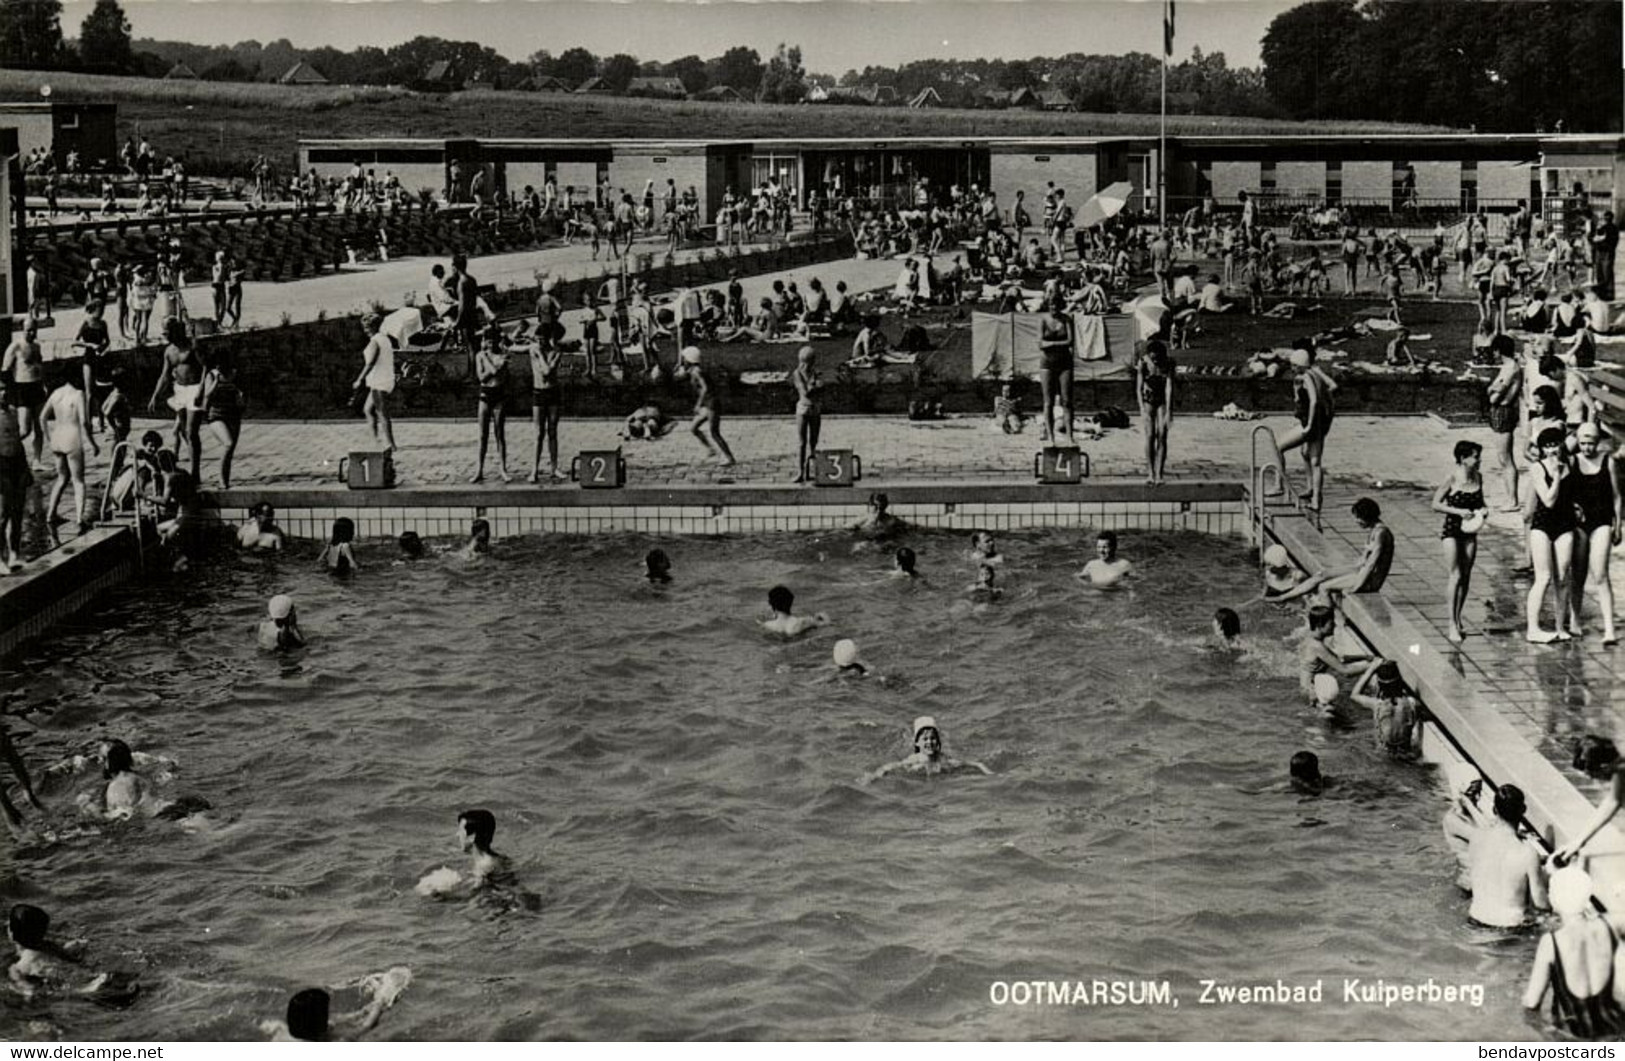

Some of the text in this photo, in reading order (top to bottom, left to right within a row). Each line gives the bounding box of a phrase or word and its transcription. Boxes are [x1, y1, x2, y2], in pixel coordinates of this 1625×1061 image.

[361, 459, 370, 482] 1
[590, 457, 606, 482] 2
[827, 455, 843, 480] 3
[1054, 452, 1071, 478] 4
